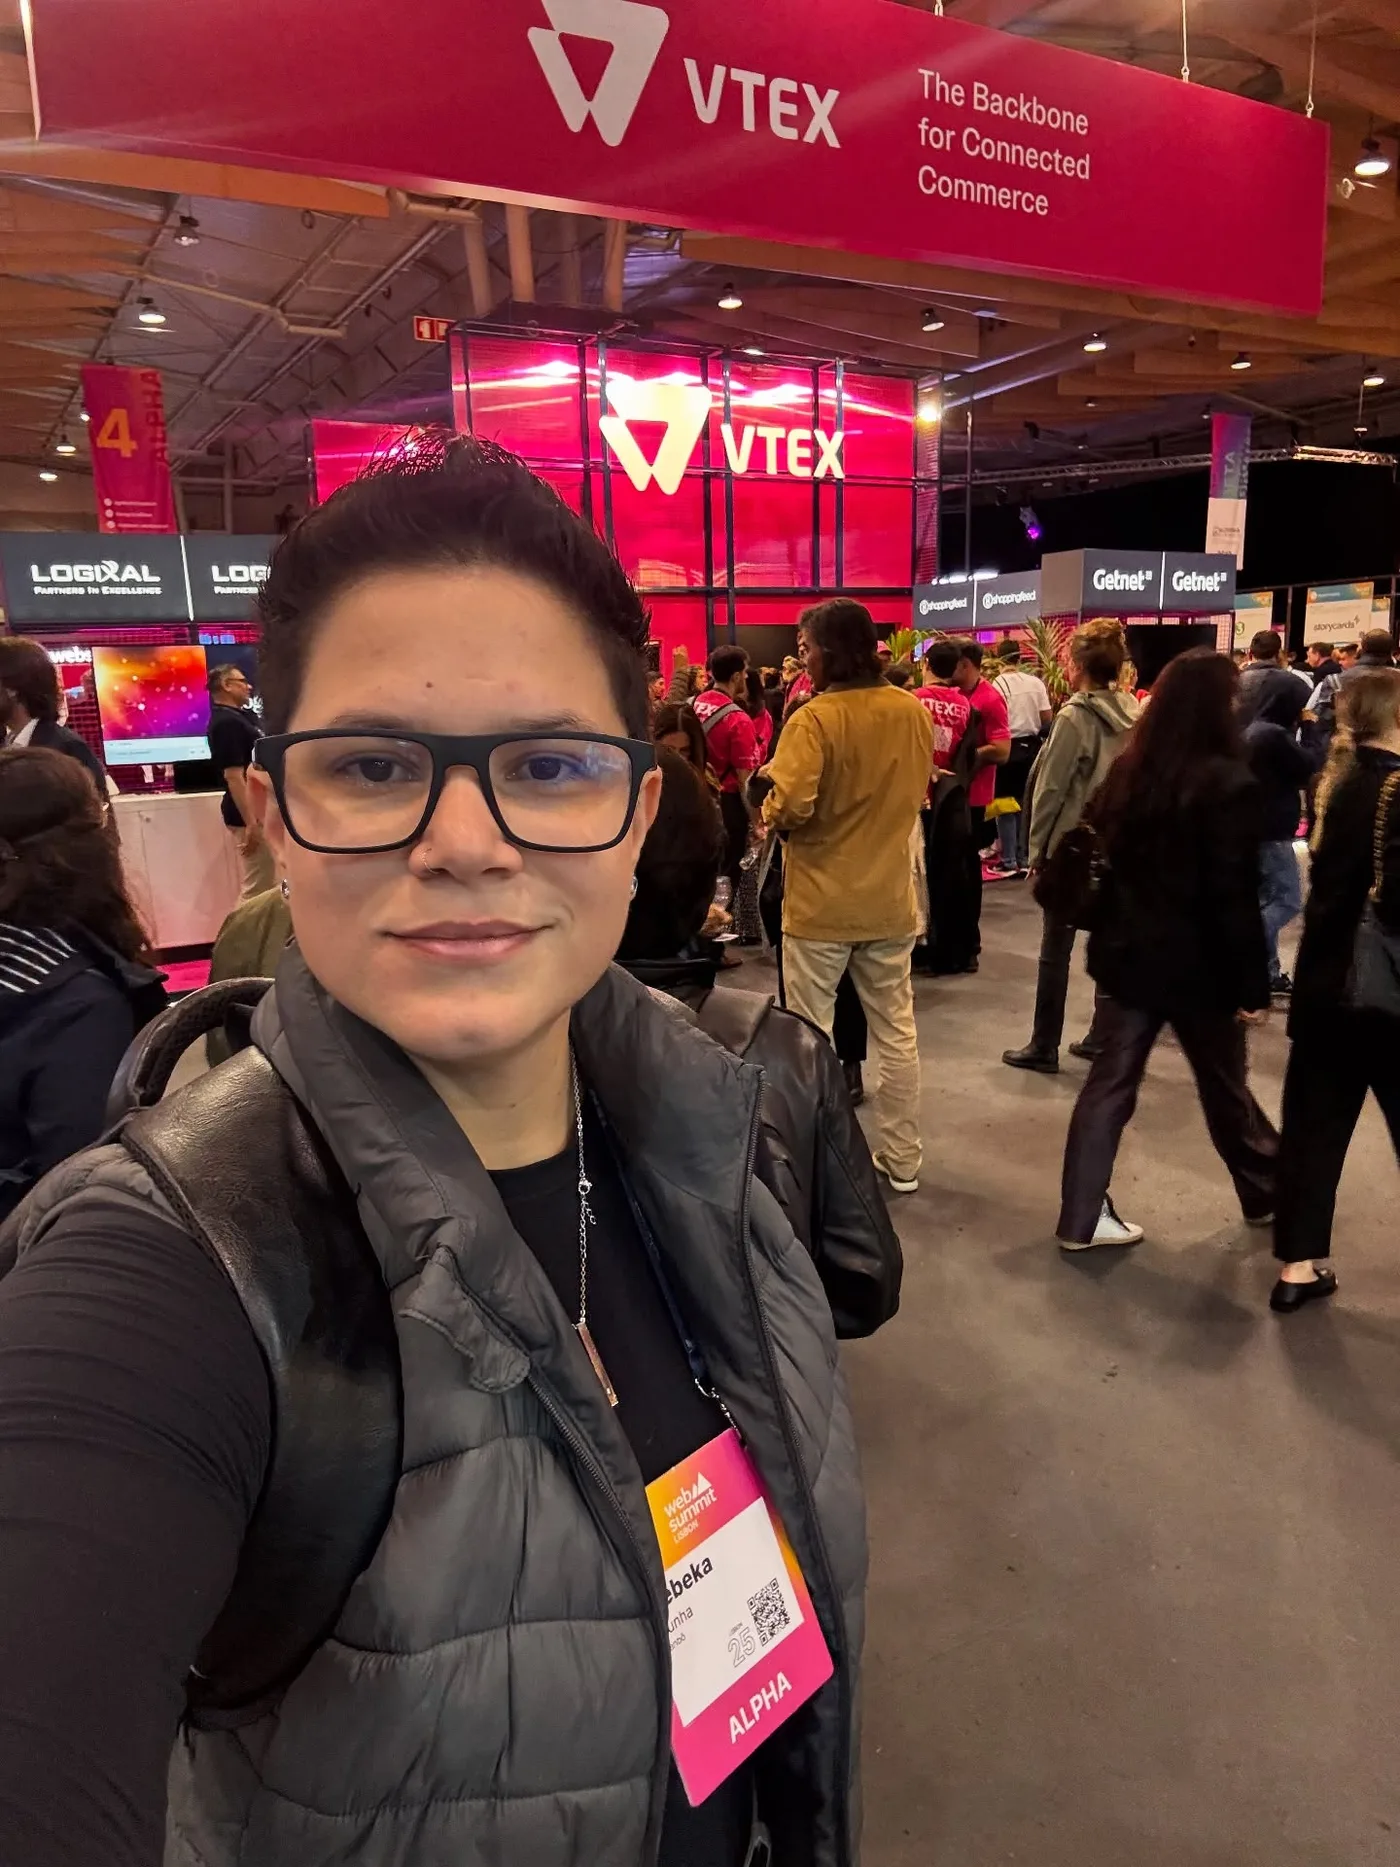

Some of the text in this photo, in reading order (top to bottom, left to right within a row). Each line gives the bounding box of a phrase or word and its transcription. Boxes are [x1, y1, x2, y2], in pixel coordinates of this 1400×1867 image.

[683, 57, 841, 148] VTEX
[918, 68, 1089, 135] The Backbone
[918, 117, 1090, 180] for Connected
[918, 165, 1049, 216] Commerce
[96, 408, 139, 458] 4
[720, 423, 845, 479] VTEX
[1093, 569, 1145, 591] Getnet
[1172, 570, 1220, 592] Getnet
[1313, 620, 1355, 632] storycards
[664, 1487, 693, 1518] web
[669, 1487, 718, 1533] summit
[673, 1519, 699, 1544] LISBON
[727, 1626, 756, 1668] 25
[729, 1671, 792, 1745] ALPHA
